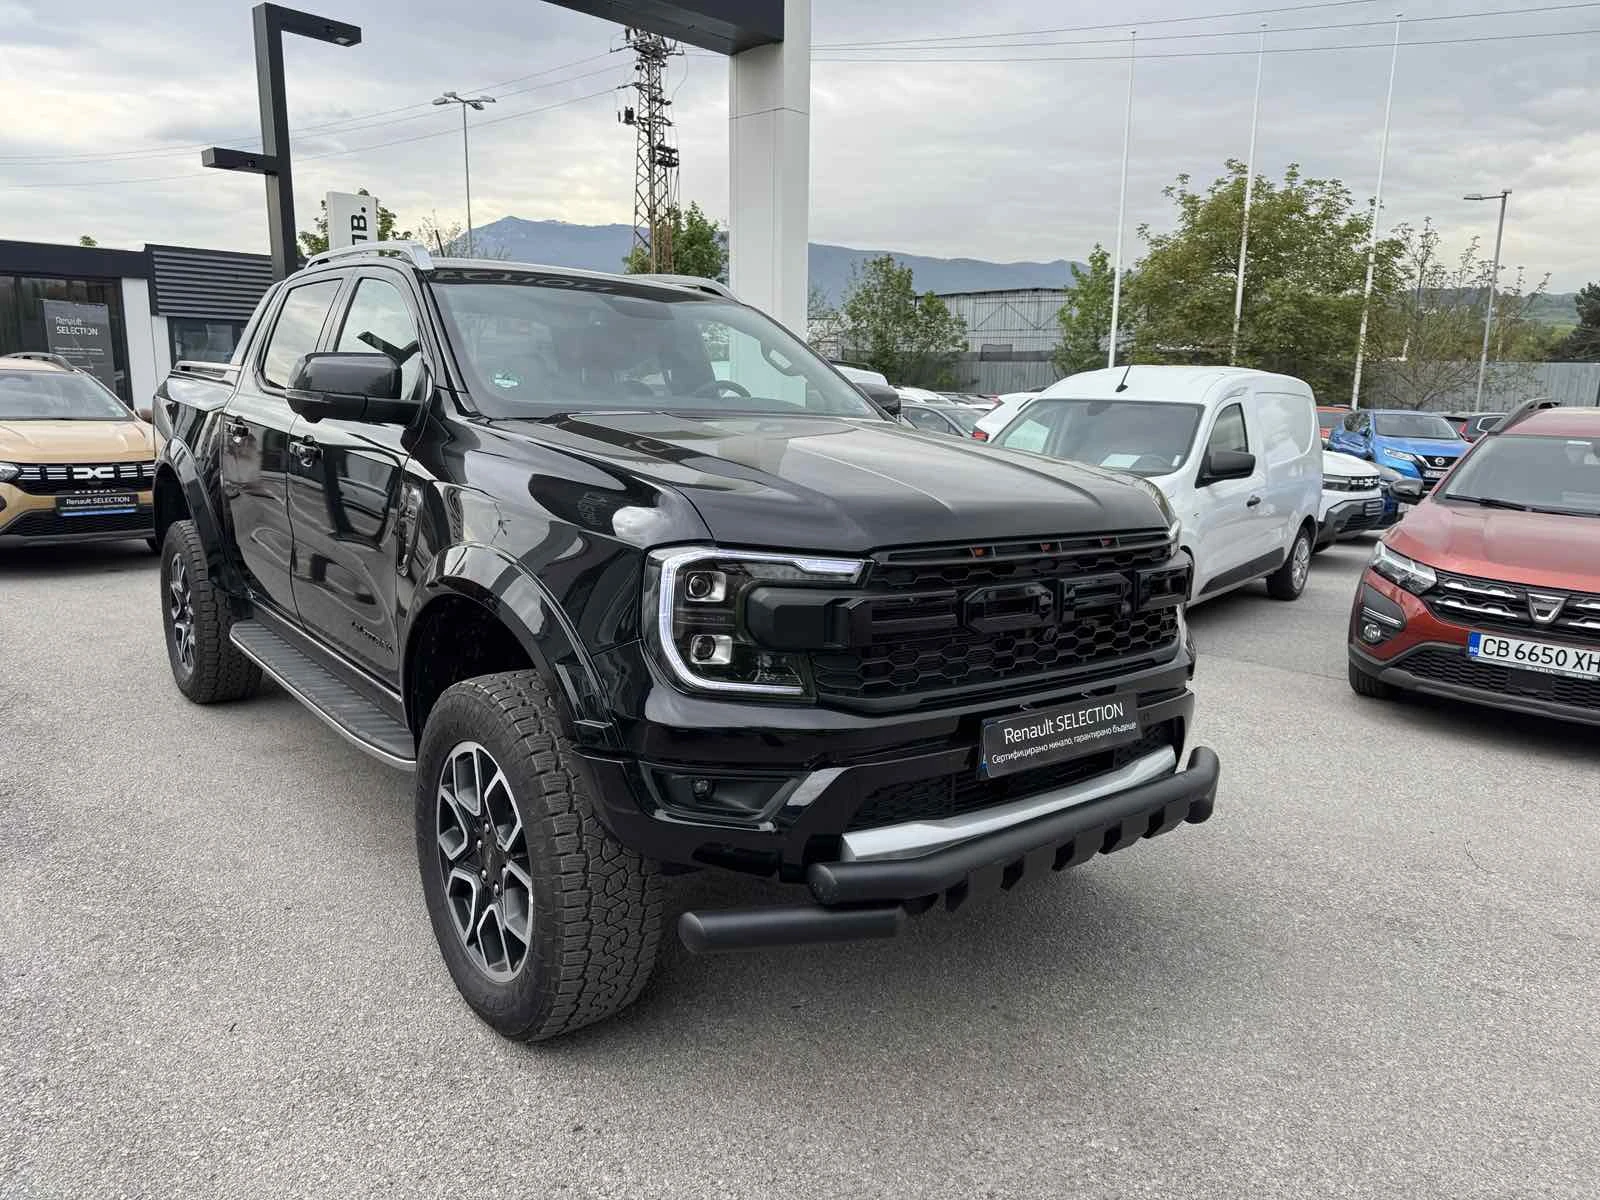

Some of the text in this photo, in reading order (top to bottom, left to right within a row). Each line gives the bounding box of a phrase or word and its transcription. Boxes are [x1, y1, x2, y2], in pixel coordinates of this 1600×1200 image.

[56, 326, 98, 336] SELECTION
[93, 496, 130, 504] SELECTION
[1483, 638, 1510, 658] CB
[1514, 643, 1568, 667] 6650
[1004, 702, 1124, 745] Renault SELECTION
[991, 744, 1048, 765] Сертифицирано
[1073, 727, 1112, 744] гарантирано
